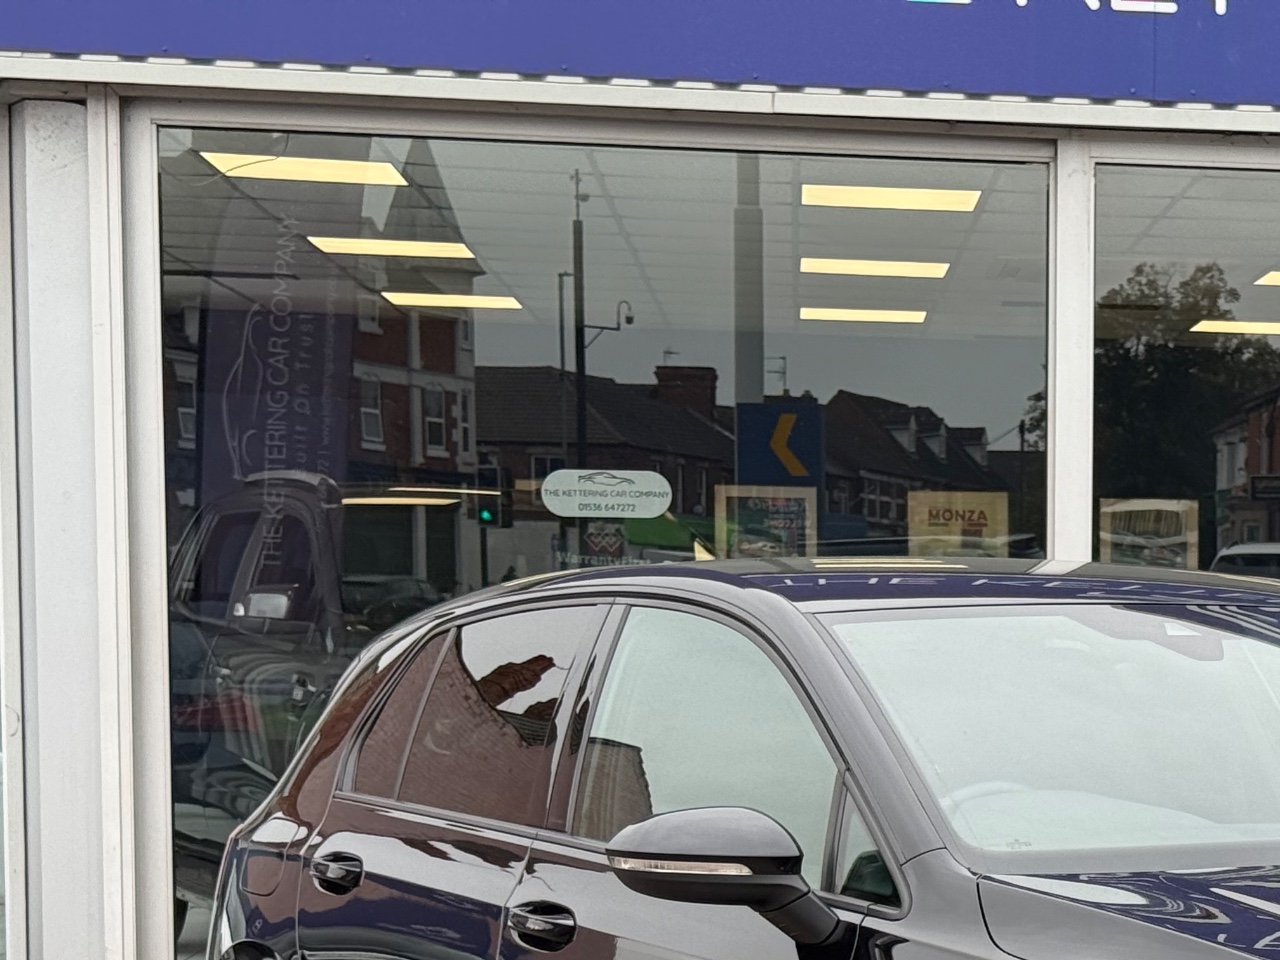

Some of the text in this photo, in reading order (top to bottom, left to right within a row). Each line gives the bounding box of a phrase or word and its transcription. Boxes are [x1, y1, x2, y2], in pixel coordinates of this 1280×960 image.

[269, 216, 300, 332] COMPANY
[265, 337, 290, 385] CAR
[543, 489, 670, 499] THE KETTERING CAR COMPANY
[578, 503, 637, 513] 01536 647272
[927, 508, 989, 522] MONZA
